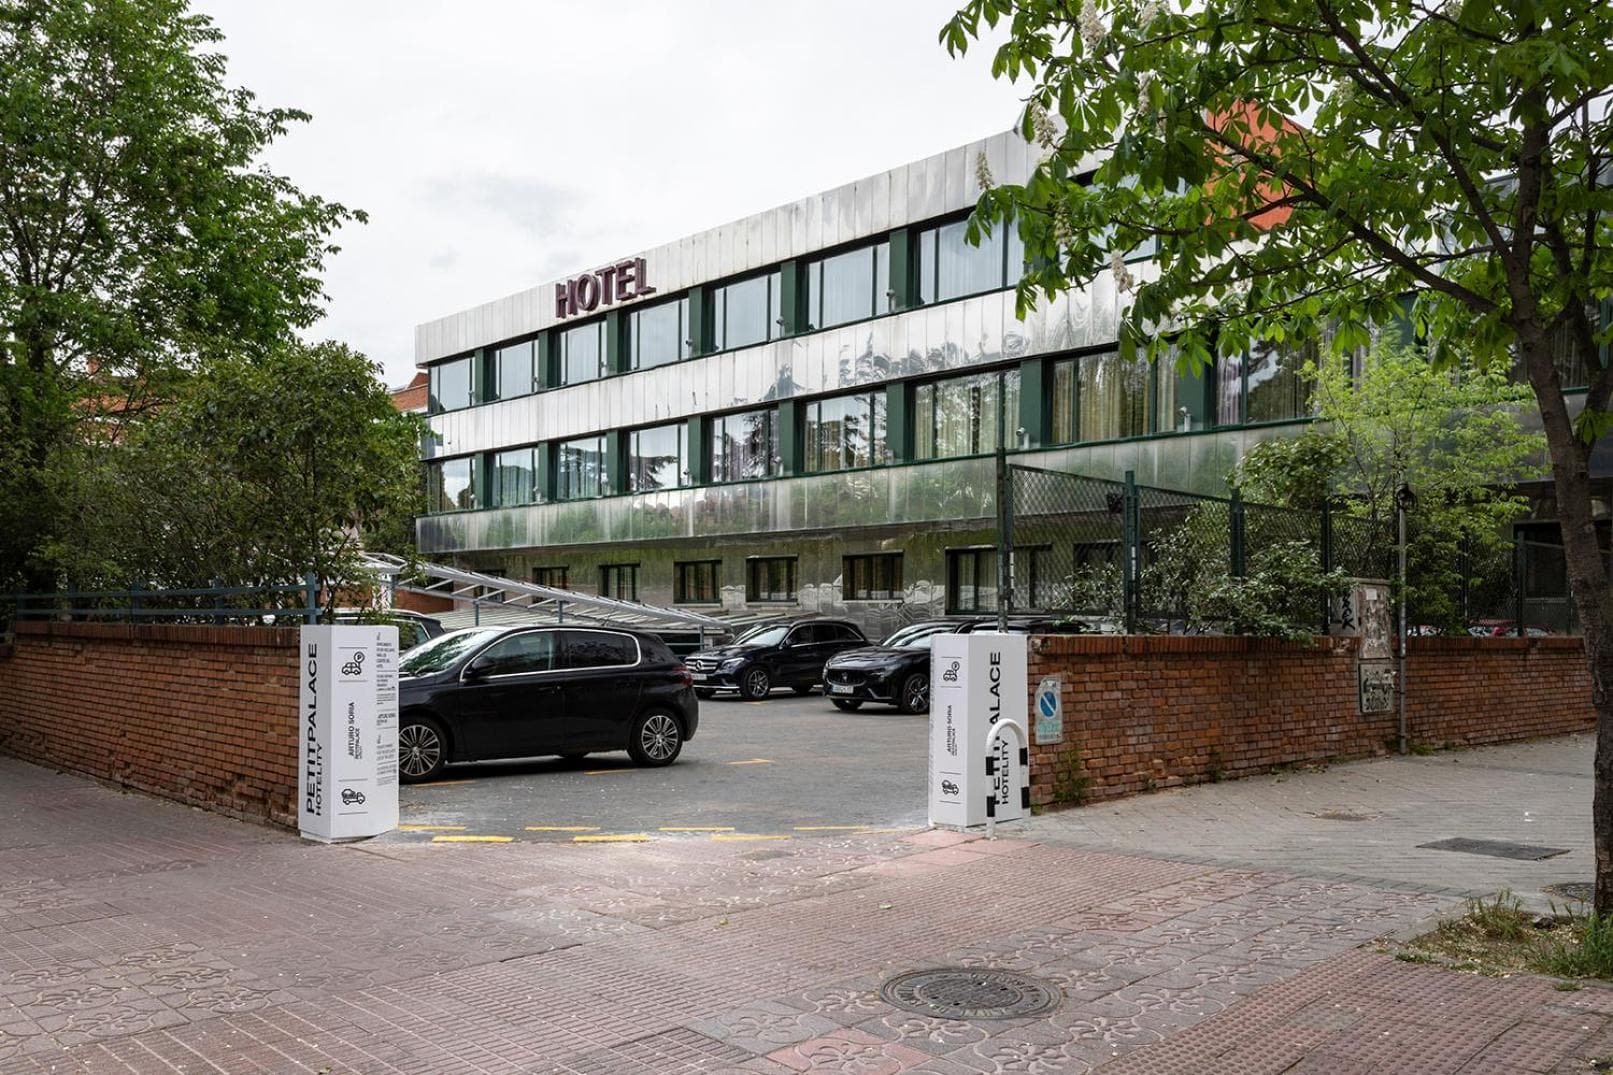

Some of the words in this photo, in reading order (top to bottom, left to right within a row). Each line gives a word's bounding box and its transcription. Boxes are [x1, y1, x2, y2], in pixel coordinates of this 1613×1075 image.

[555, 257, 656, 318] HOTEL
[306, 643, 317, 814] PETITPALACE
[1001, 740, 1009, 804] HOTELITY
